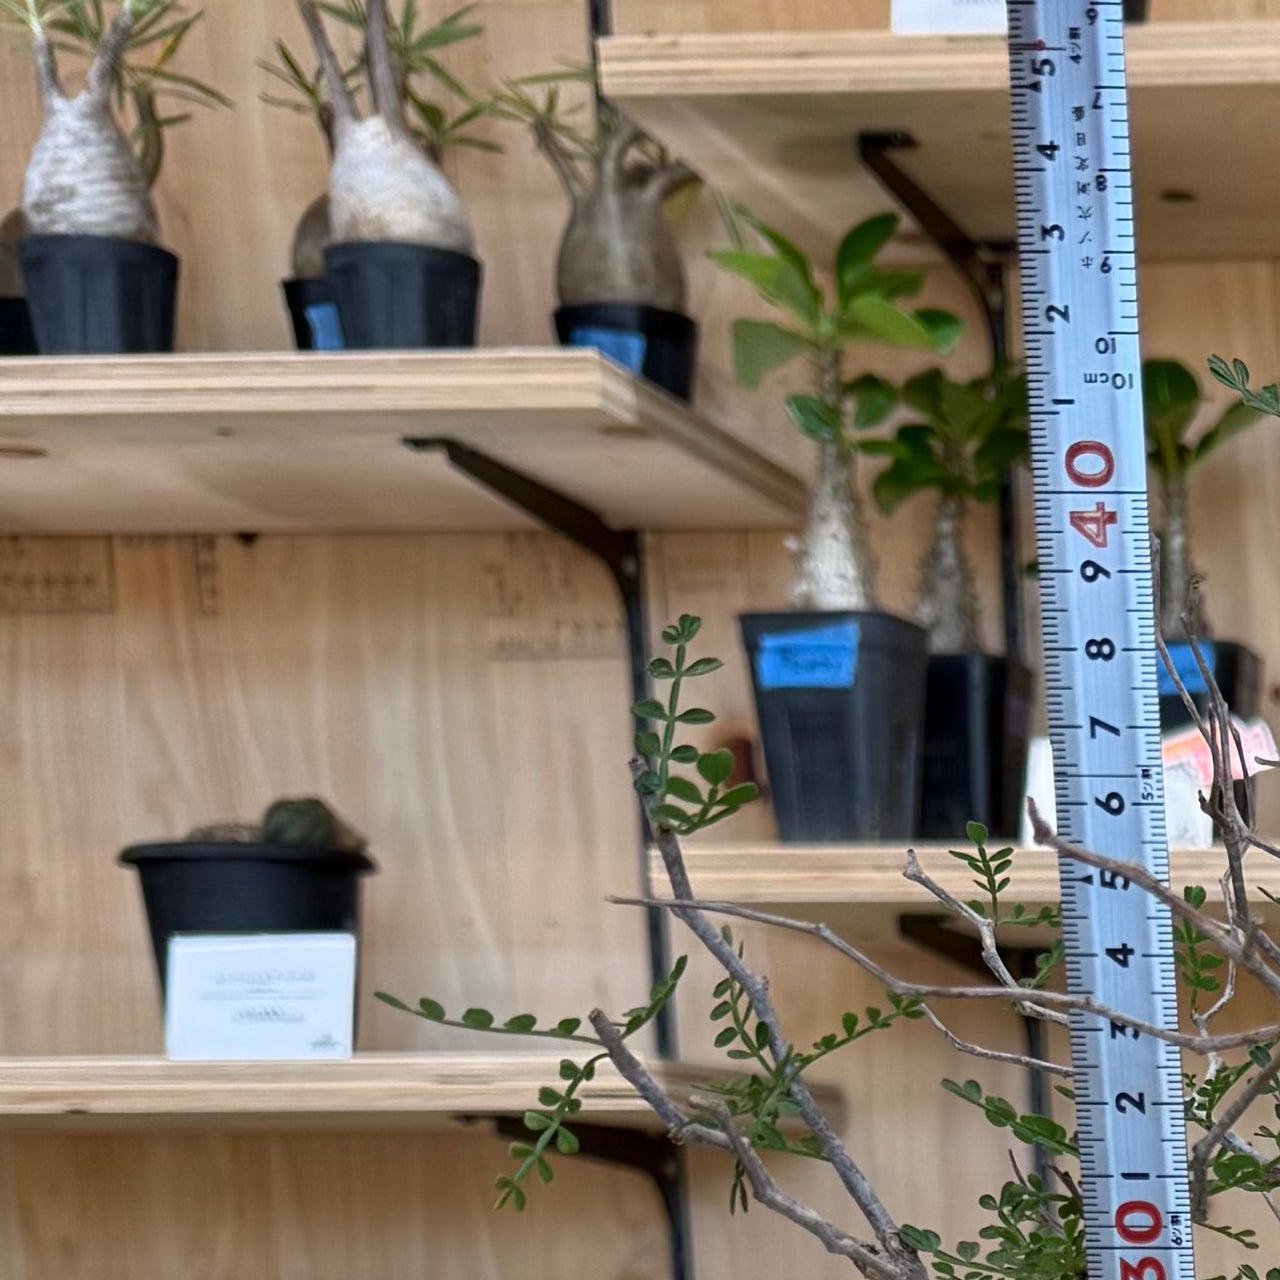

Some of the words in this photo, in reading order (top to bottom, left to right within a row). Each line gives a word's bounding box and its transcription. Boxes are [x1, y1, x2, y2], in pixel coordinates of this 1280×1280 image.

[1086, 9, 1098, 24] 6
[1031, 59, 1056, 76] 5
[1091, 92, 1104, 109] 7
[1037, 141, 1060, 161] 4
[1095, 174, 1108, 191] 8
[1041, 223, 1065, 241] 3
[1100, 257, 1112, 273] 9
[1046, 305, 1070, 323] 2
[1095, 337, 1116, 355] 10
[1084, 373, 1133, 389] 10cm
[1065, 441, 1117, 548] 40
[1080, 560, 1111, 583] 9
[1085, 638, 1116, 661] 8
[1089, 716, 1121, 739] 7
[1095, 791, 1126, 816] 6
[1101, 870, 1130, 891] 5
[1106, 943, 1135, 968] 4
[1116, 1091, 1146, 1114] 2
